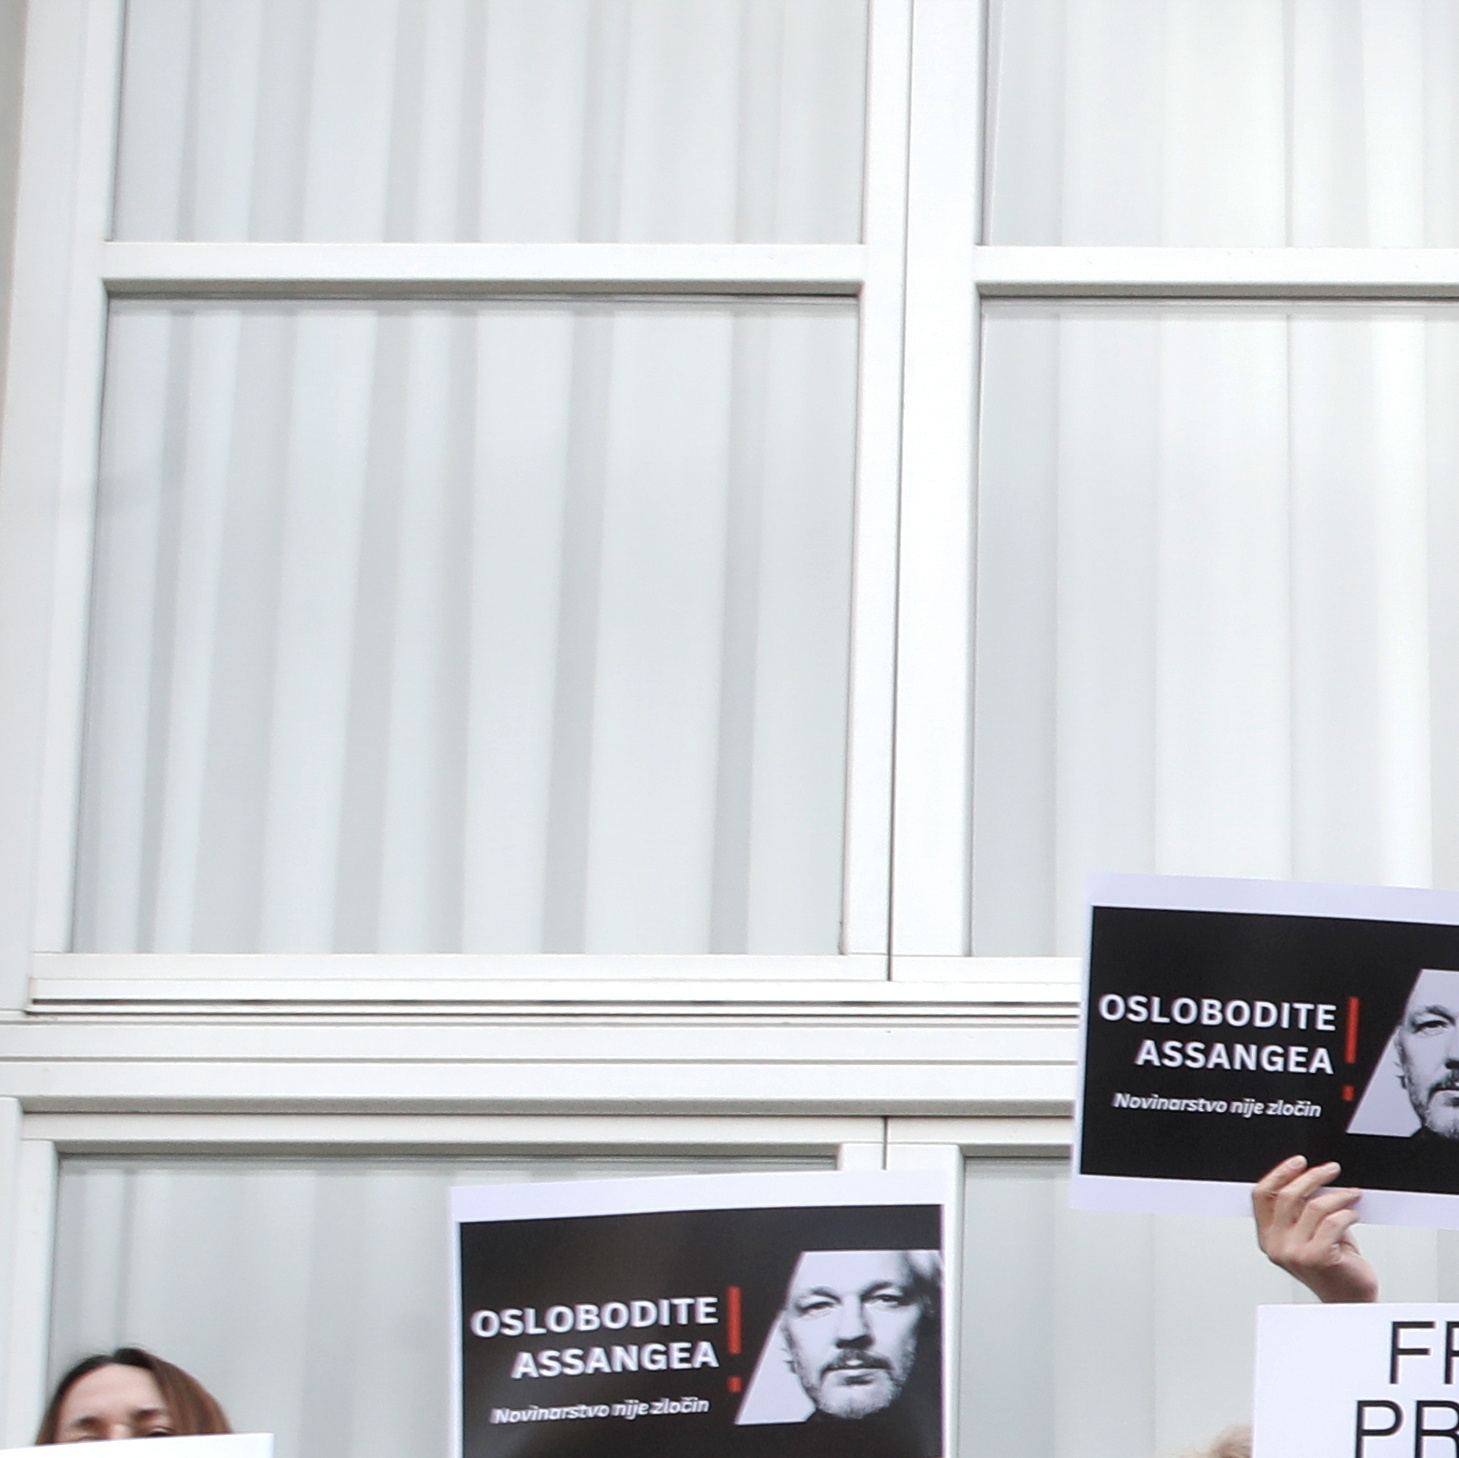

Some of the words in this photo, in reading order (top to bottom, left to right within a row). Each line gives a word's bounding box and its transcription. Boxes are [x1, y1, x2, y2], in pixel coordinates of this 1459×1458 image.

[1100, 993, 1337, 1031] OSLOBODITE
[1135, 1039, 1335, 1075] ASSANGEA
[1112, 1092, 1228, 1114] Novinarstvo
[1230, 1098, 1264, 1118] nije
[1266, 1099, 1322, 1118] zločin
[471, 1296, 719, 1338] OSLOBODITE
[511, 1341, 719, 1379] ASSANGEA
[490, 1405, 610, 1424] Novinarstvo
[612, 1400, 649, 1420] nije
[651, 1397, 709, 1415] zločin
